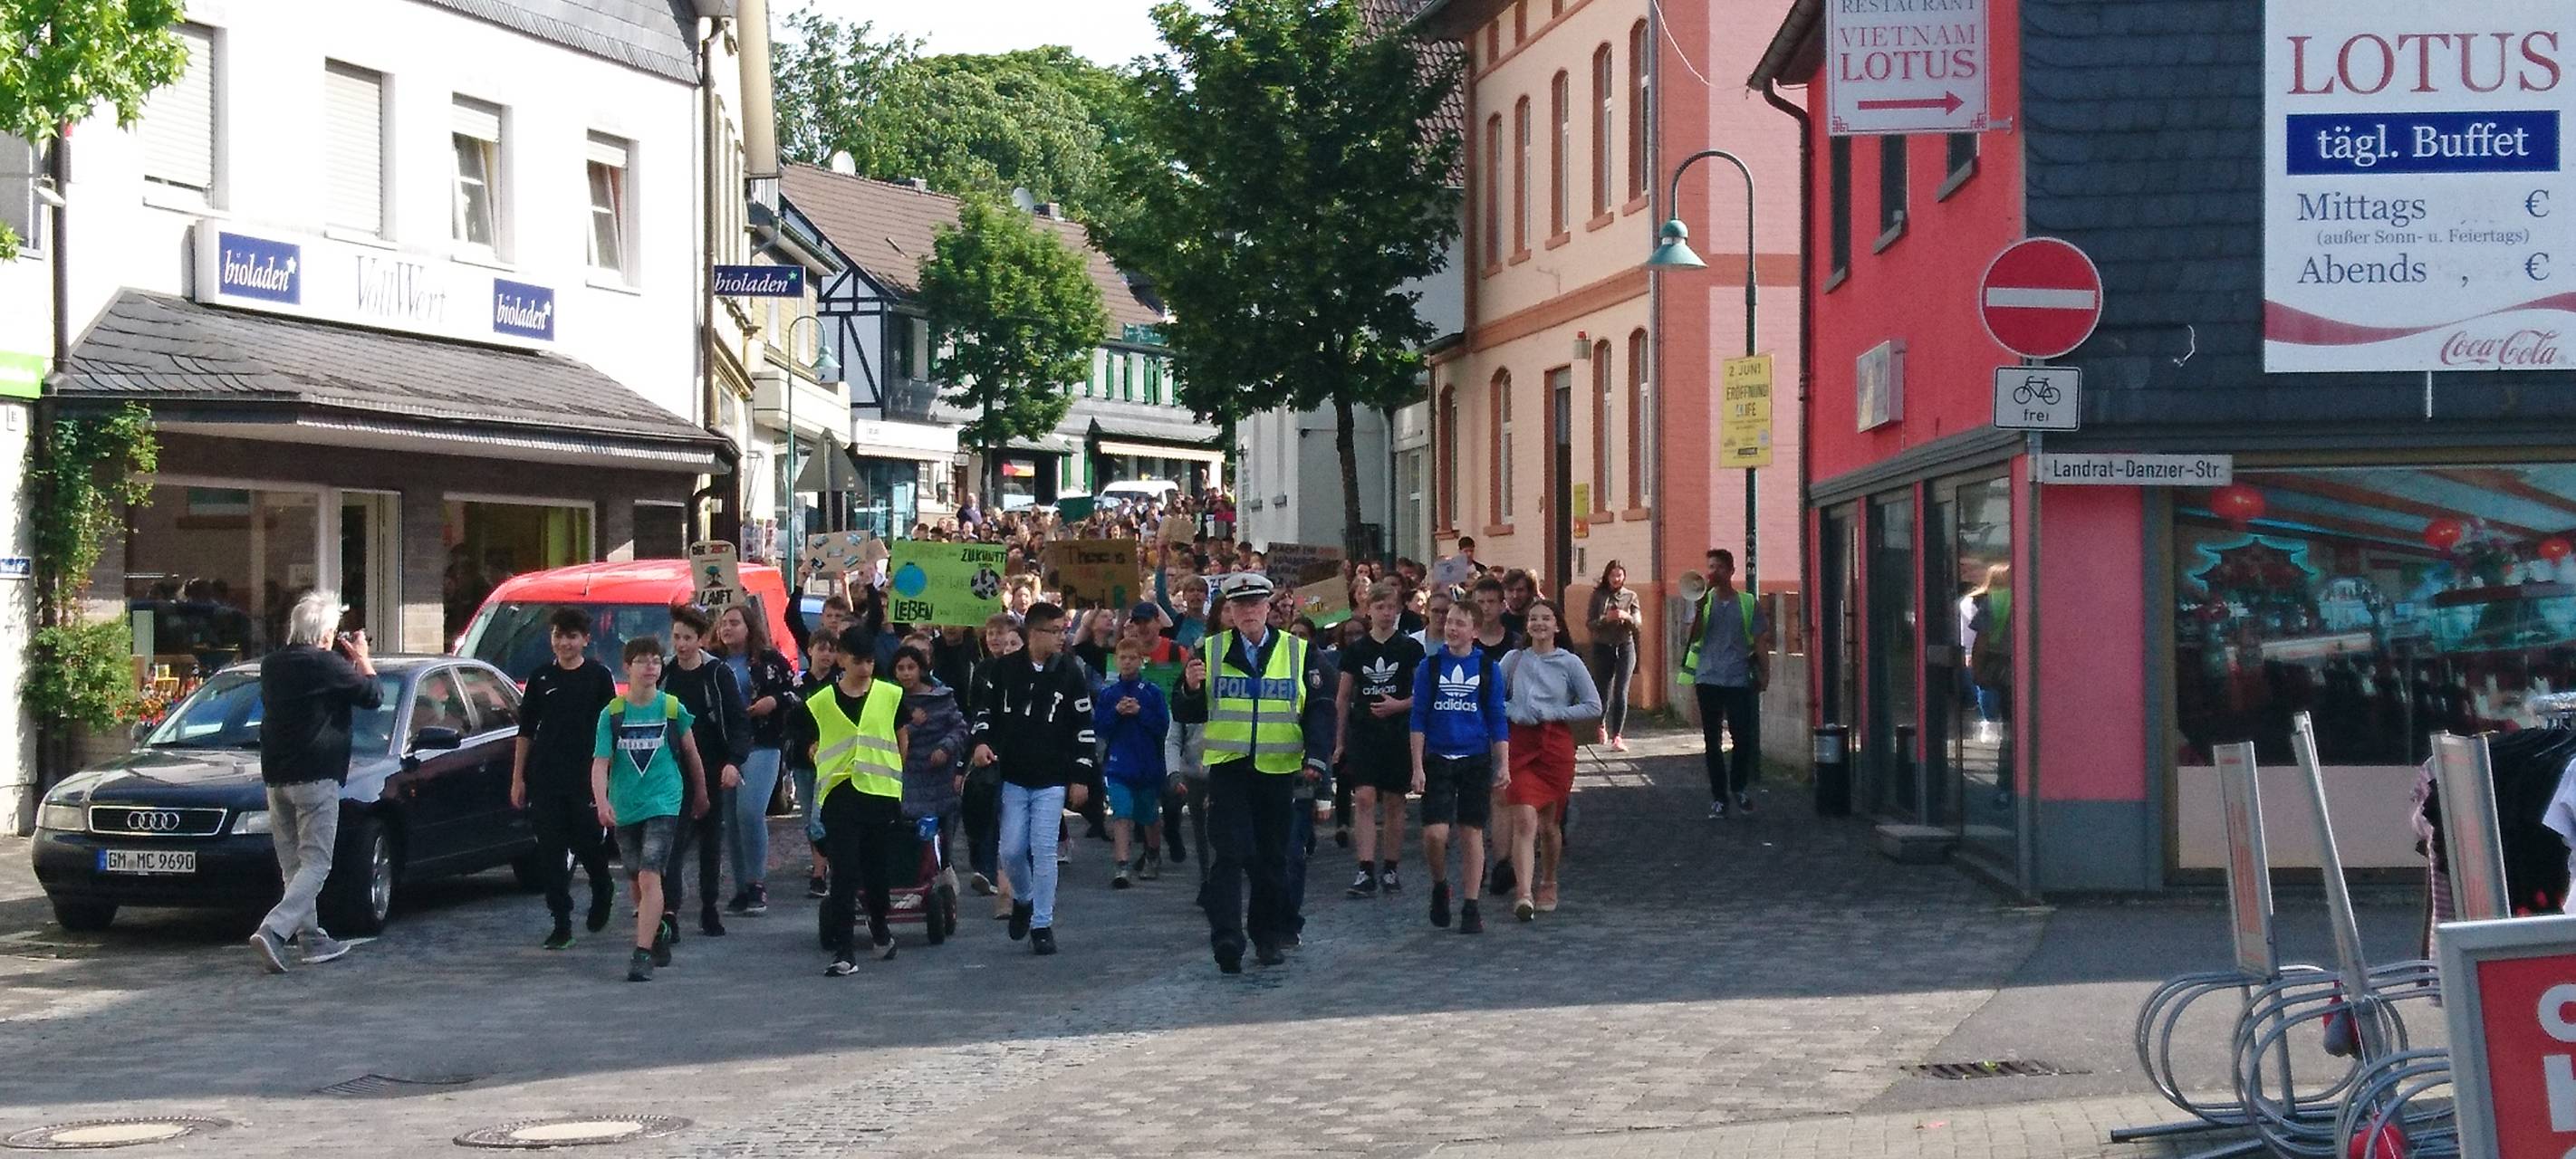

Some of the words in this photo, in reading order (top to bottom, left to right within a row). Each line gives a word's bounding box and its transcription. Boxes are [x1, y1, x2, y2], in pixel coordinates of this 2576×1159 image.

[1840, 24, 1976, 46] VIETNAM
[1841, 49, 1977, 81] LOTUS
[2286, 30, 2562, 95] LOTUS
[2317, 124, 2398, 167] tägl.
[2412, 122, 2529, 158] Buffet
[2297, 192, 2427, 227] Mittags
[2524, 189, 2550, 217] €
[2317, 229, 2370, 245] (außer
[2374, 229, 2423, 244] Sonn-
[2429, 230, 2443, 244] u.
[2449, 227, 2531, 244] Feiertags)
[2297, 253, 2427, 284] Abends
[2524, 252, 2550, 281] €
[224, 249, 289, 292] bioladen
[496, 293, 548, 330] bioladen
[716, 272, 788, 292] bioladen
[2440, 329, 2561, 366] Coca-Cola
[2023, 408, 2049, 422] frei
[894, 599, 934, 621] LEBEN
[1217, 677, 1293, 698] POLIZEI
[1434, 698, 1477, 713] adidas
[109, 852, 127, 868] GM
[137, 853, 155, 869] MC
[159, 853, 194, 870] 9690
